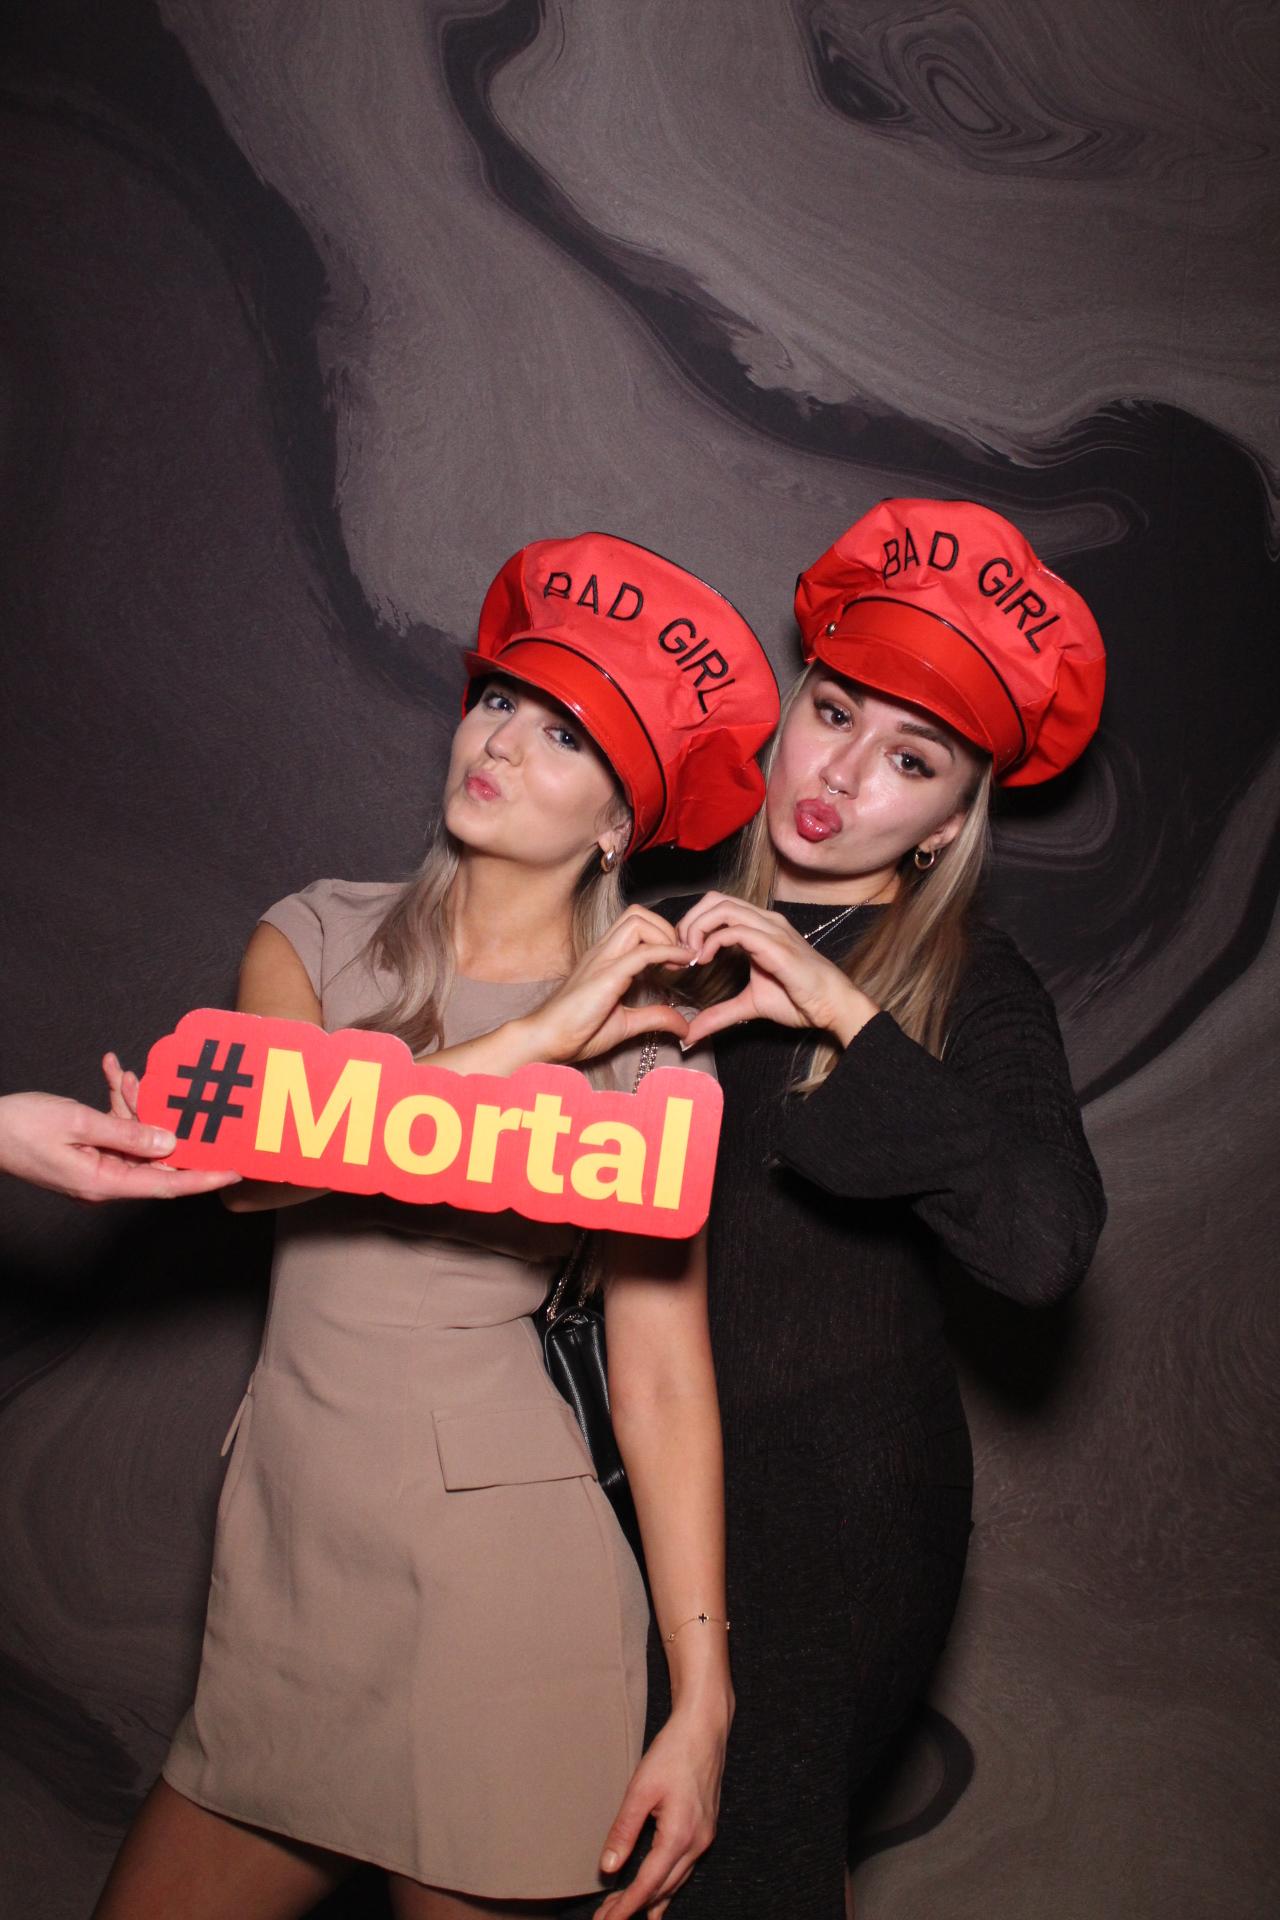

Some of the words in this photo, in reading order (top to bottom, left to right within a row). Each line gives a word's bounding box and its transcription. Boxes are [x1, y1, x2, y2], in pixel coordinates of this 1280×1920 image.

[883, 528, 959, 580] BAD
[978, 557, 1060, 654] GIRL
[658, 618, 735, 714] GIRL
[167, 1039, 693, 1210] #Mortal
